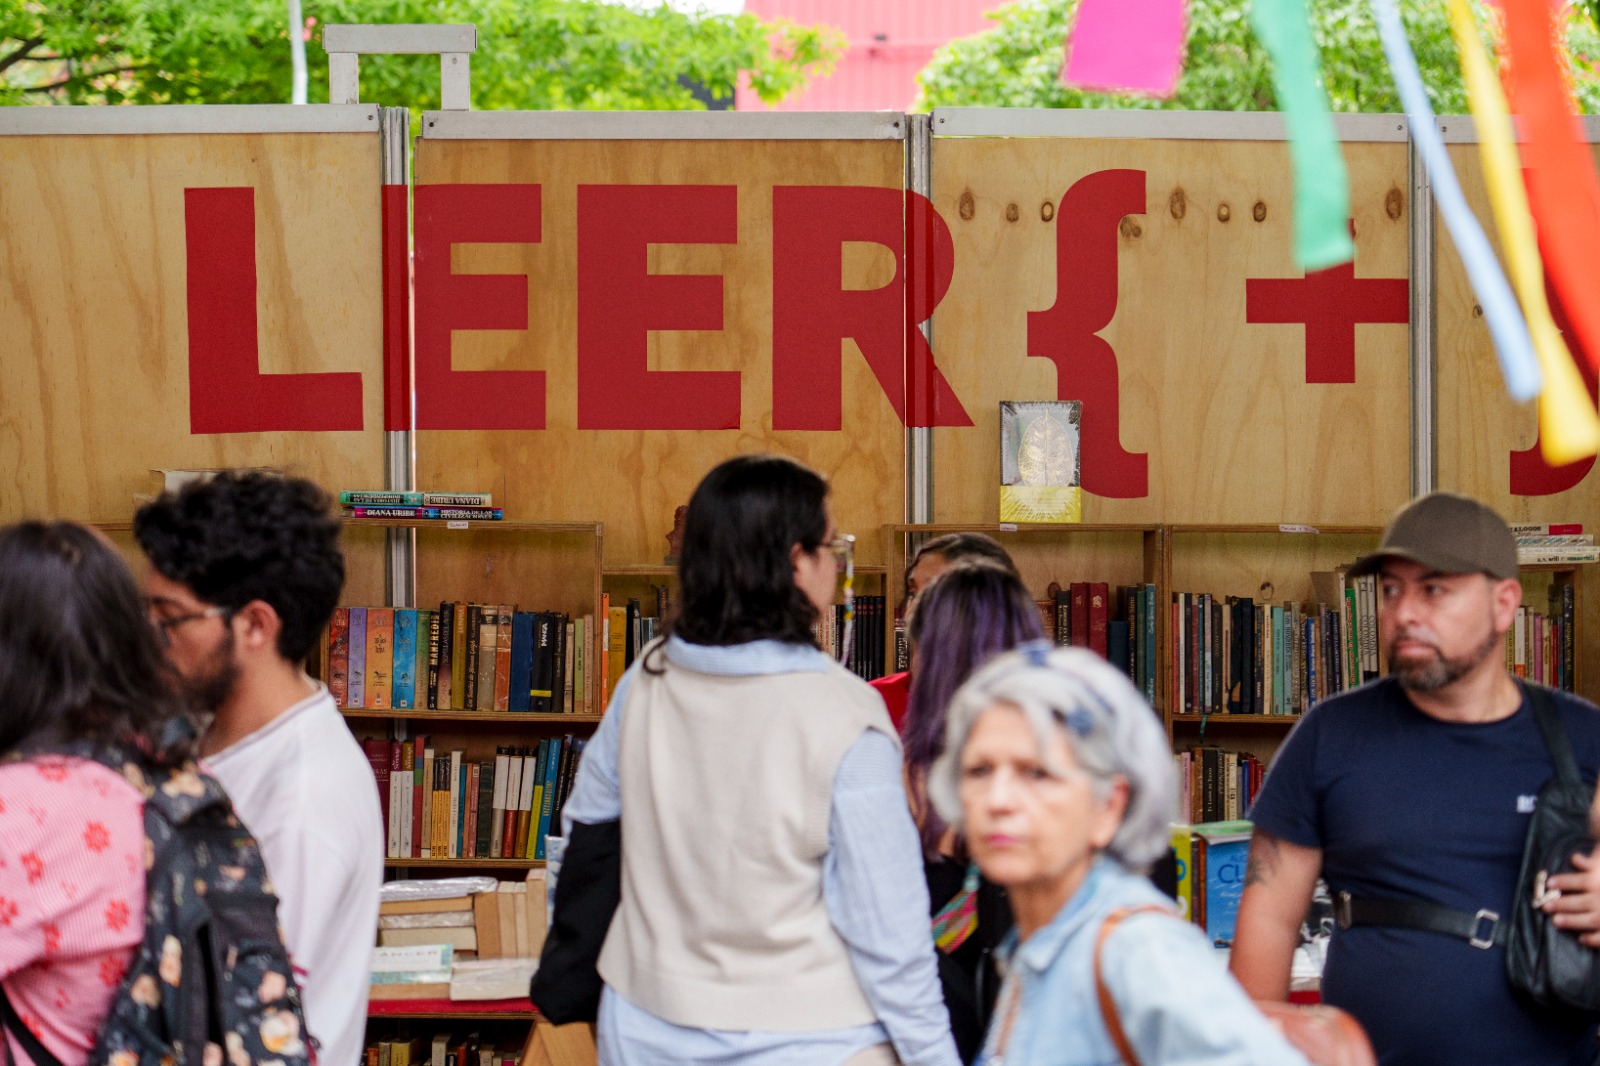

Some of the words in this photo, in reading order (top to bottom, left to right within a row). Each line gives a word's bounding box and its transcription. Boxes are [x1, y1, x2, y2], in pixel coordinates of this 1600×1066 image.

[184, 183, 975, 434] LEER
[430, 496, 454, 504] URIBE
[454, 497, 480, 505] DIANA
[366, 509, 391, 517] DIANA
[392, 509, 415, 517] URIBE
